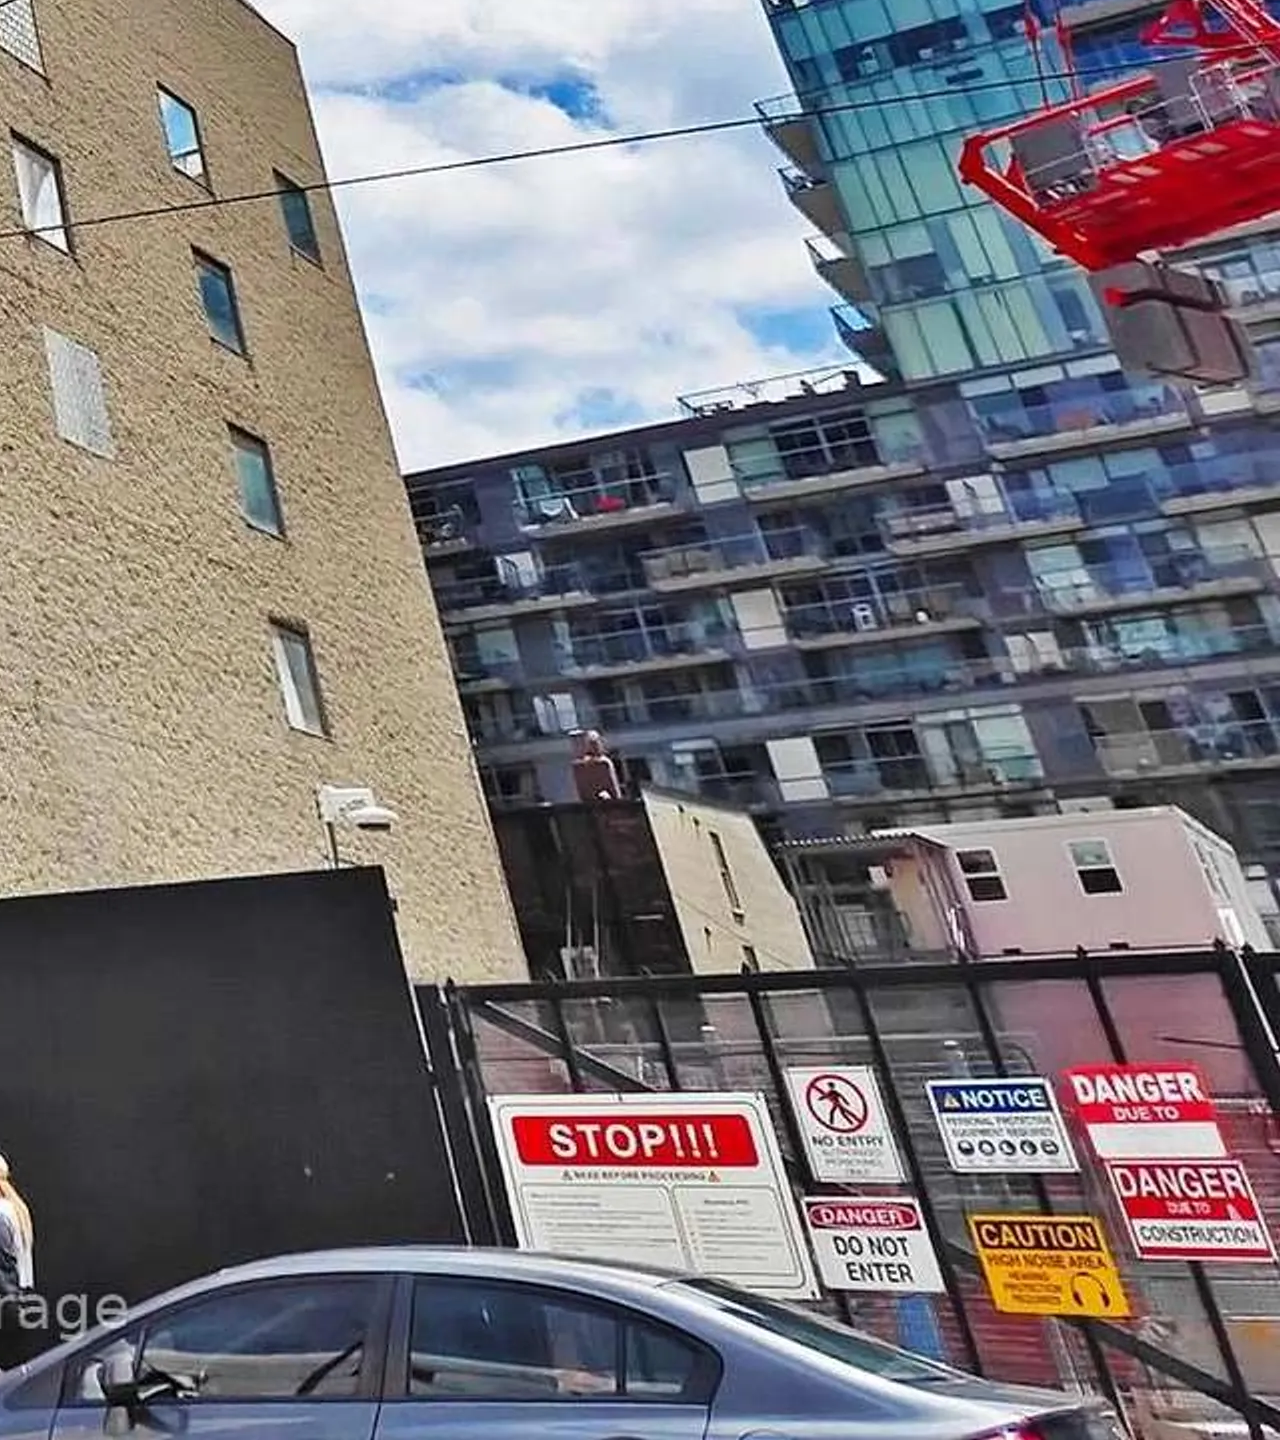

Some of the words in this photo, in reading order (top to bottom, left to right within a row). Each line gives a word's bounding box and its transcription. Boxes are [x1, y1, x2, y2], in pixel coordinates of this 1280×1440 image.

[1069, 1071, 1206, 1105] DANGER
[960, 1089, 1047, 1108] NOTICE
[1112, 1107, 1153, 1121] DUE
[1156, 1106, 1180, 1120] TO
[548, 1123, 720, 1159] STOP!!!
[812, 1135, 834, 1148] NO
[837, 1135, 884, 1148] ENTRY
[1112, 1167, 1248, 1198] DANGER
[820, 1207, 904, 1225] DANGER
[1165, 1201, 1189, 1214] DUE
[1191, 1201, 1211, 1214] TO
[980, 1223, 1097, 1248] CAUTION
[1140, 1224, 1260, 1242] CONSTRUCTION
[833, 1235, 864, 1256] DO
[867, 1236, 910, 1257] NOT
[987, 1253, 1022, 1267] HIGH
[1024, 1254, 1067, 1269] NOISE
[1068, 1255, 1108, 1270] AREA
[845, 1261, 914, 1283] ENTER
